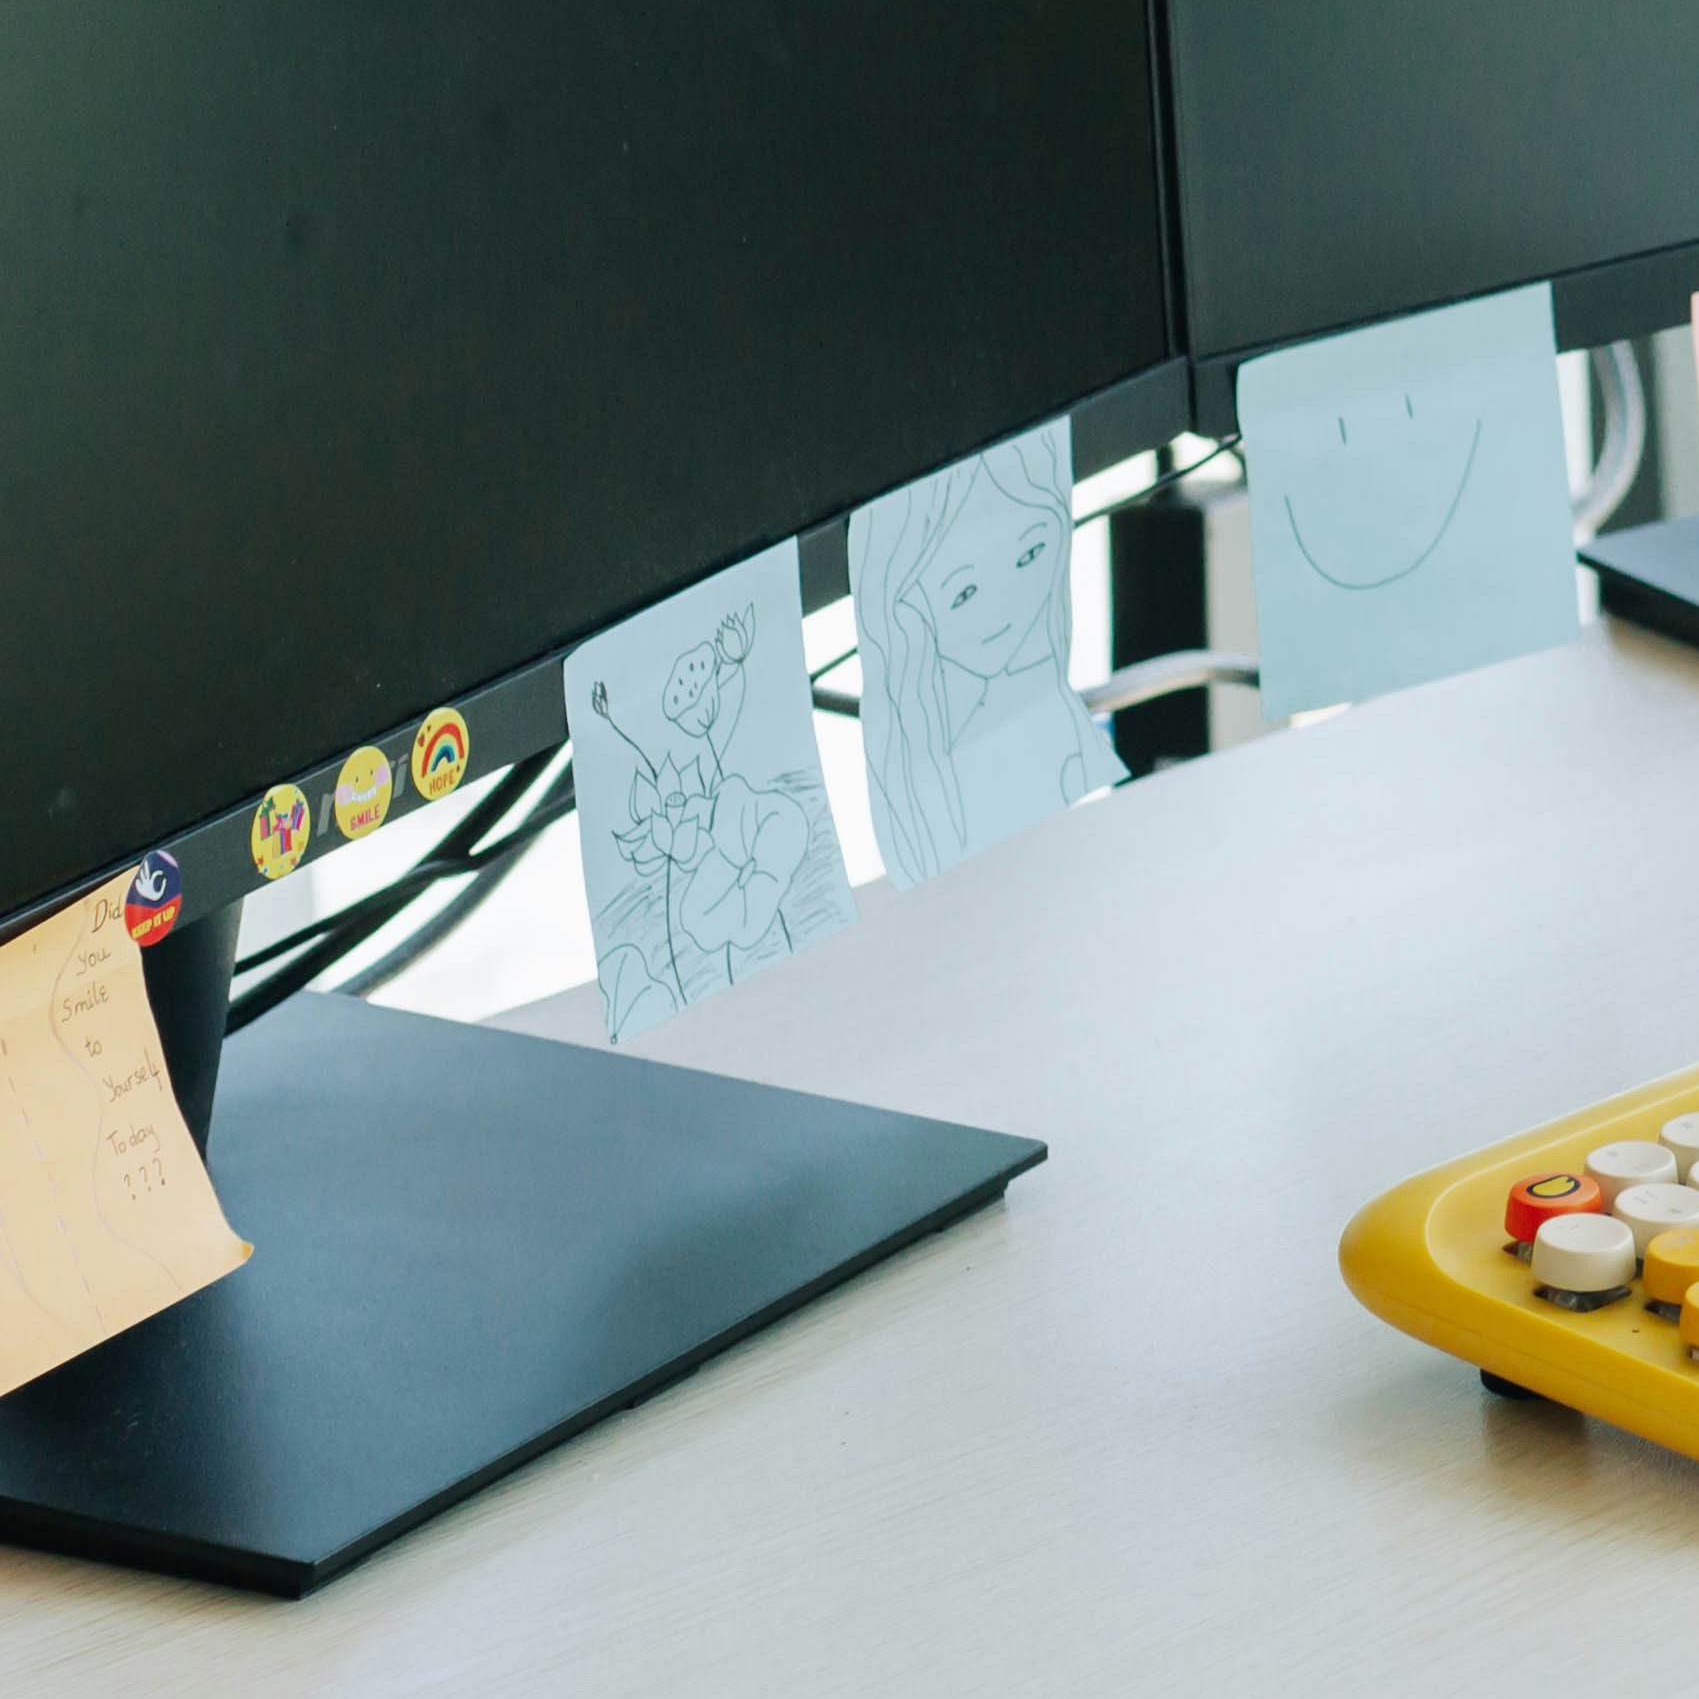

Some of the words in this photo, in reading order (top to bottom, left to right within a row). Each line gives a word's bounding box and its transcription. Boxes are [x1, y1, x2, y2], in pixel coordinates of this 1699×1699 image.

[428, 768, 456, 796] HOPE
[349, 803, 381, 832] SMILE
[91, 892, 123, 933] Did
[162, 905, 176, 922] UP
[85, 1036, 102, 1057] to
